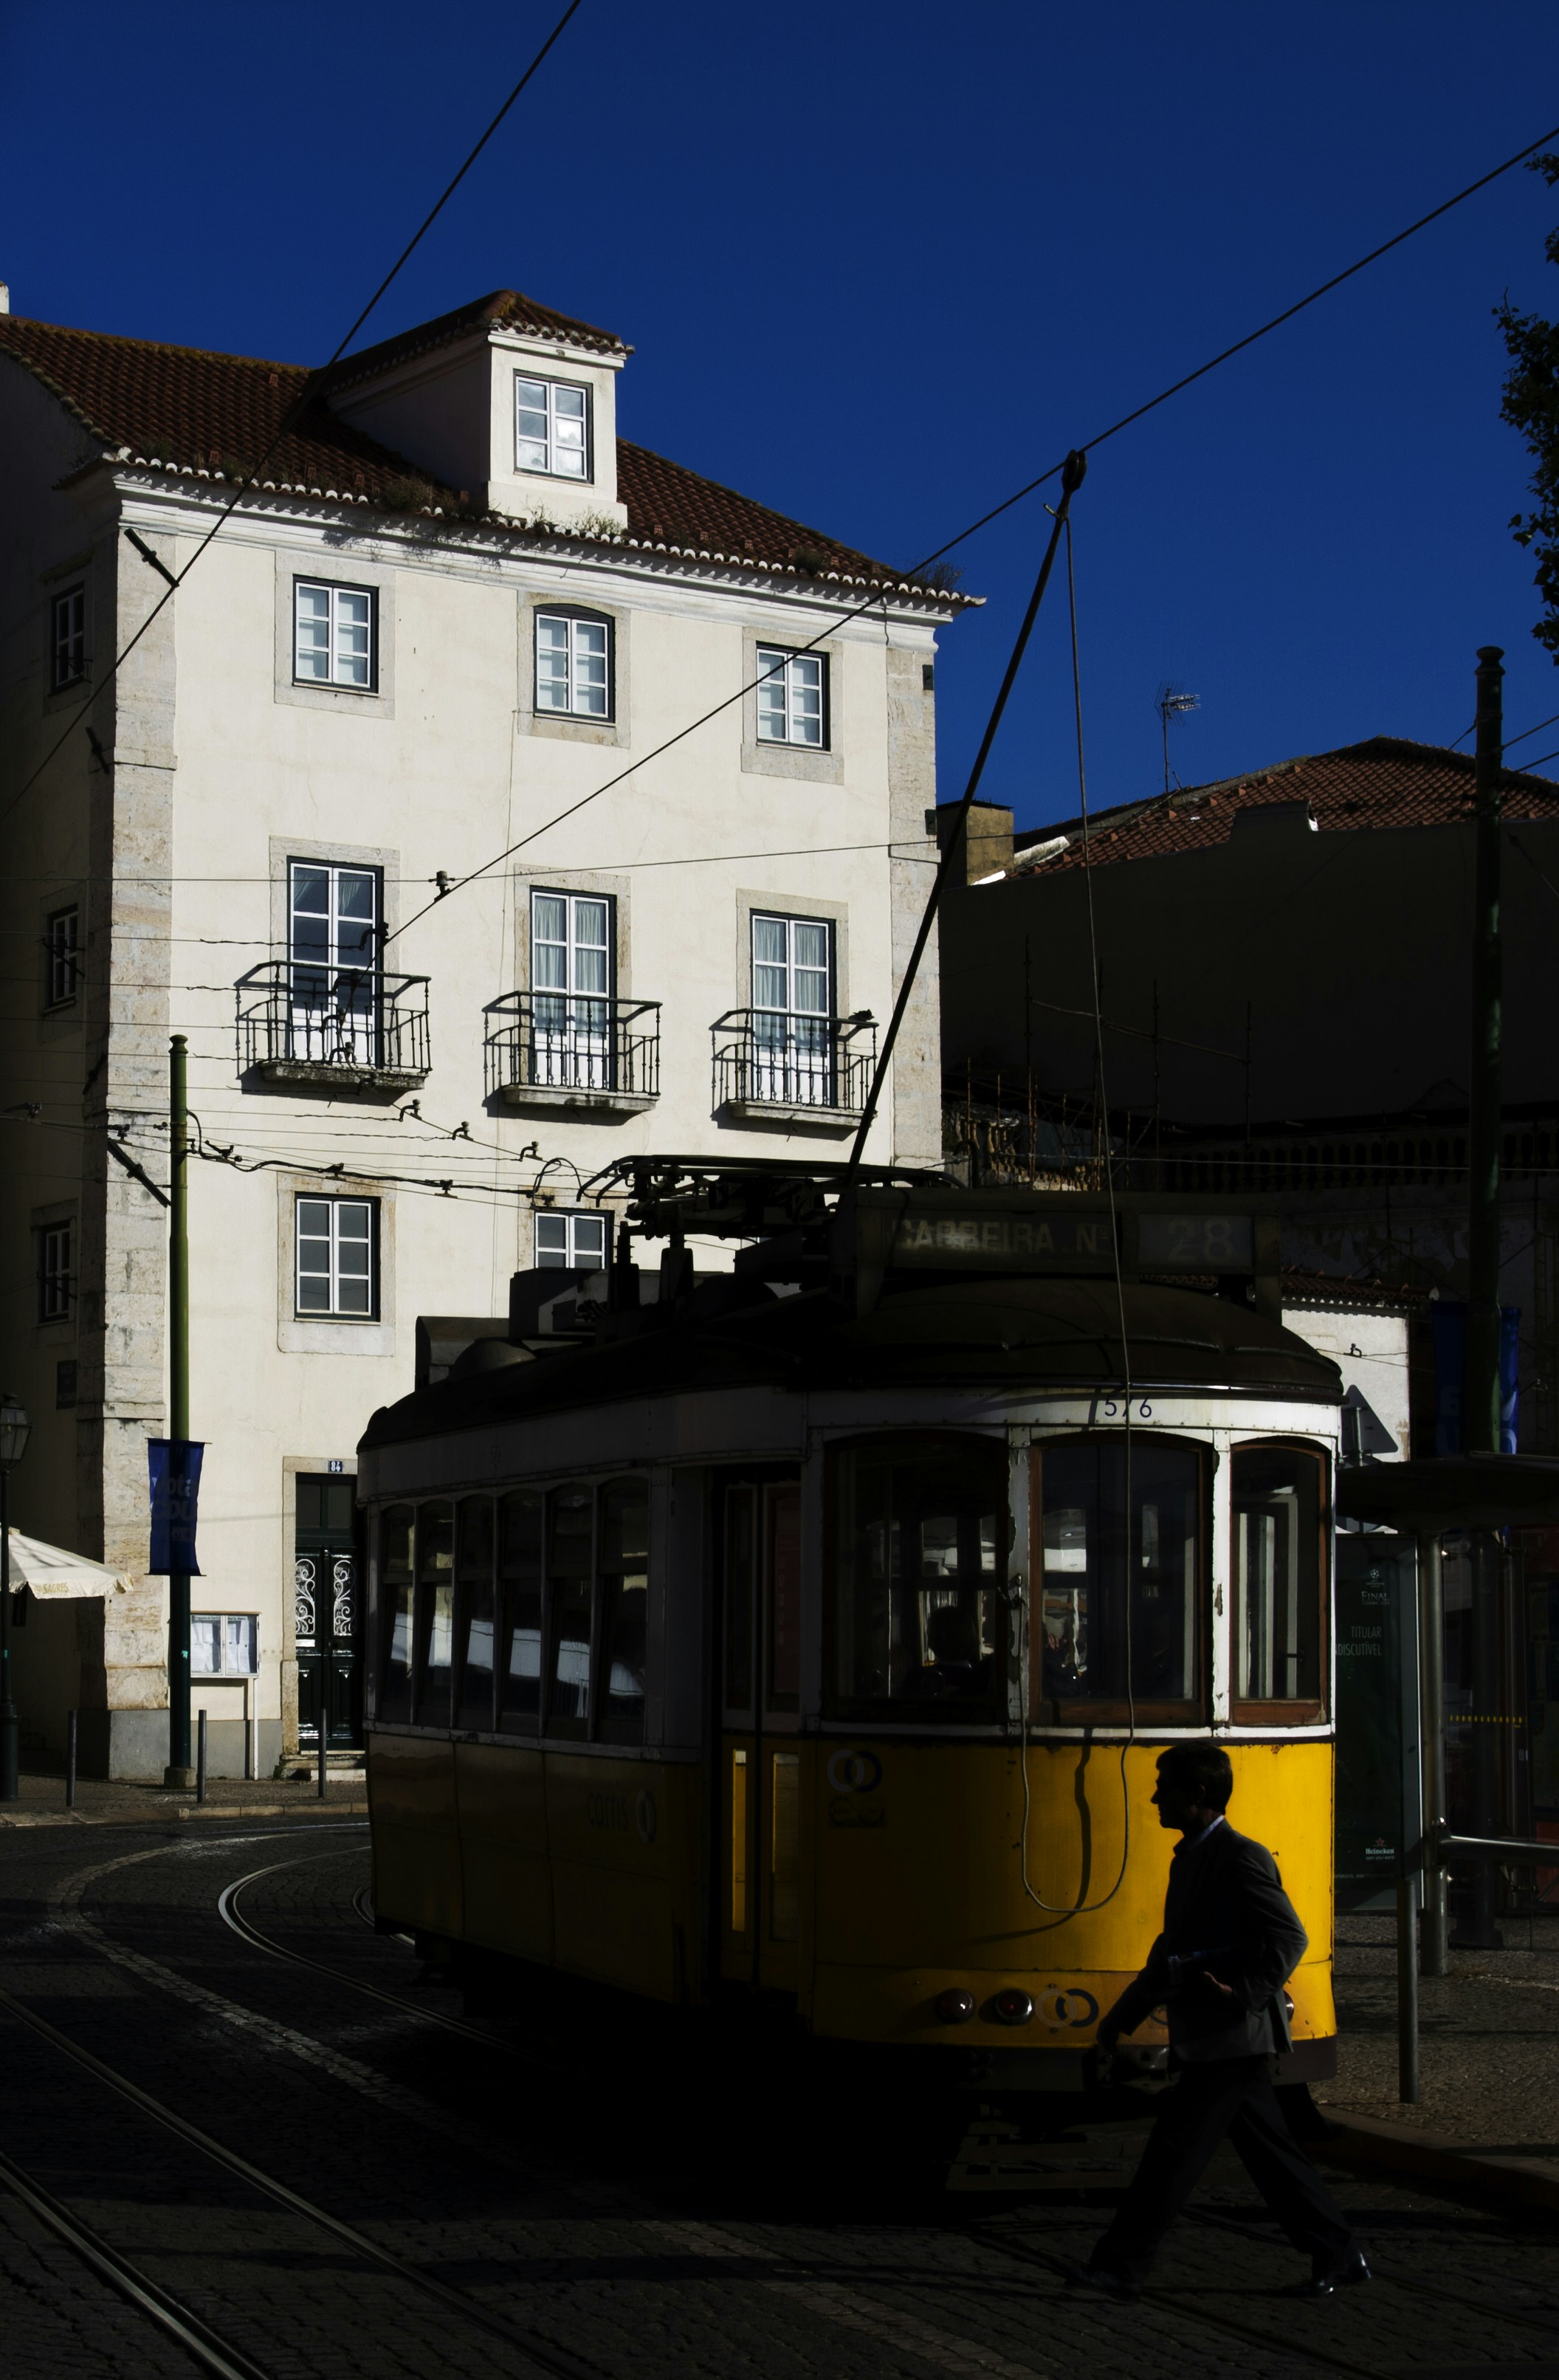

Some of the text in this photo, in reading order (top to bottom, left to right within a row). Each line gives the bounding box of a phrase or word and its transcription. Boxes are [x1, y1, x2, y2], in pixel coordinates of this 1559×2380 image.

[1166, 1217, 1233, 1265] 28
[1104, 1394, 1152, 1418] 576
[330, 1461, 341, 1472] 84
[152, 1499, 197, 1522] CDU
[1351, 1626, 1382, 1638] TITULAR
[1335, 1640, 1382, 1656] DISCUTÍVEL
